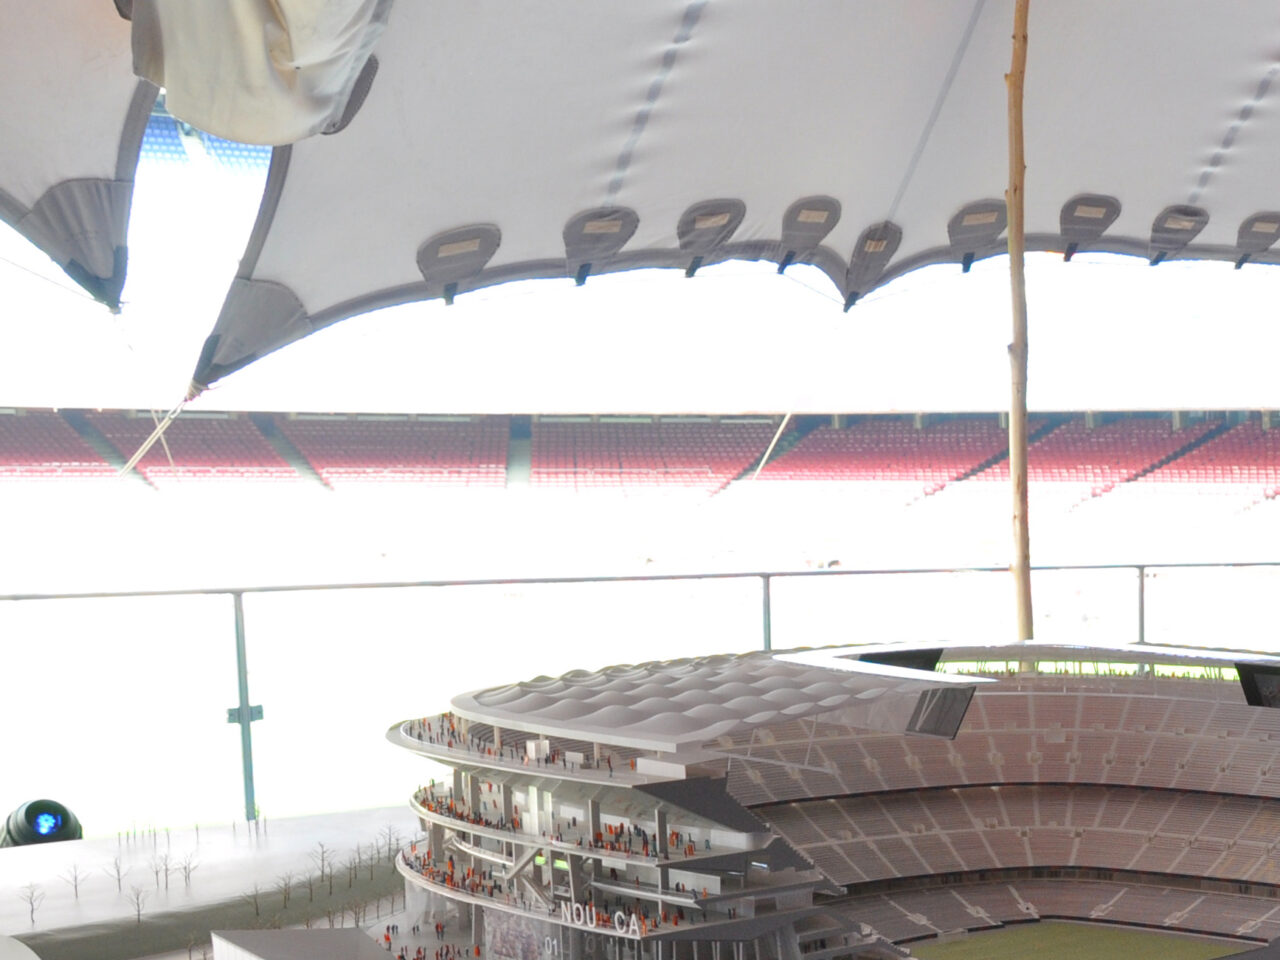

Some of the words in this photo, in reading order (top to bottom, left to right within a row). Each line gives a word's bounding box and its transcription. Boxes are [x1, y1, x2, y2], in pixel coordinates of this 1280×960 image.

[561, 900, 597, 929] NOU
[613, 910, 641, 939] CA
[544, 936, 558, 956] 01
